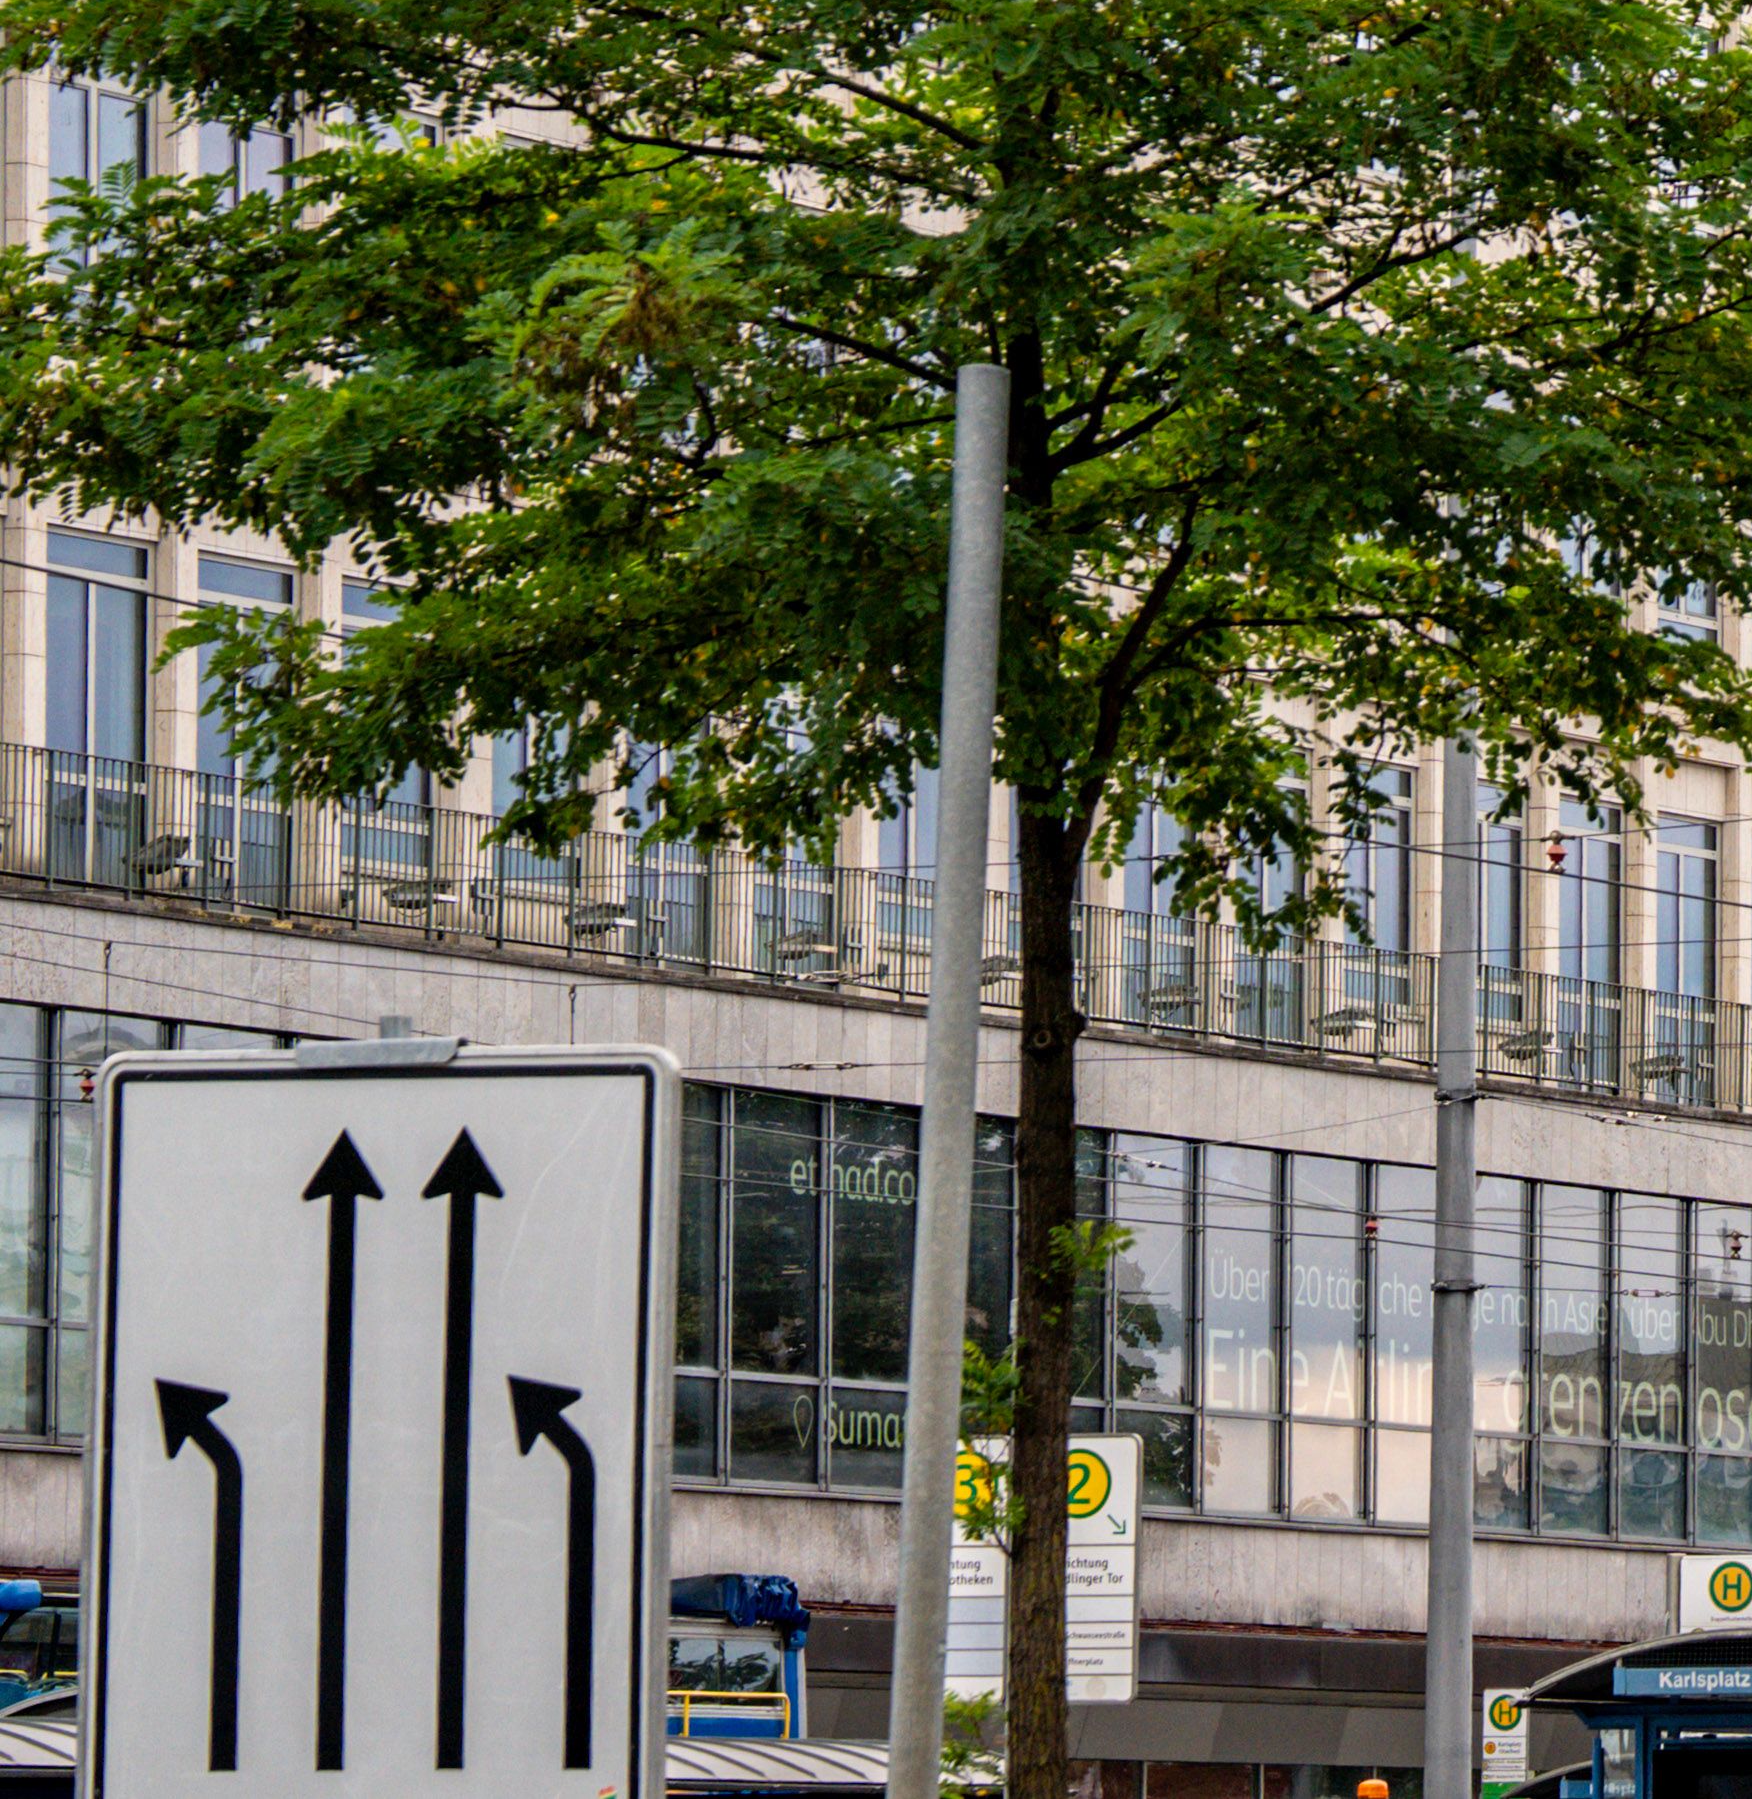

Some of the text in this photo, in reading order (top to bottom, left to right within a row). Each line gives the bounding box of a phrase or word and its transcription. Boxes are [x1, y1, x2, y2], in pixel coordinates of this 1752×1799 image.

[1209, 1249, 1271, 1302] Über
[1291, 1265, 1322, 1308] 20
[1501, 1289, 1558, 1330] nah
[1563, 1292, 1611, 1336] Asie
[1207, 1328, 1310, 1416] Eine
[821, 1400, 906, 1449] Suma
[1067, 1463, 1091, 1505] 2
[1066, 1557, 1109, 1571] ichtung
[948, 1573, 994, 1586] otheken
[1065, 1573, 1124, 1587] dlinger Tor
[1722, 1573, 1742, 1601] H
[1659, 1672, 1751, 1691] Karlsplatz
